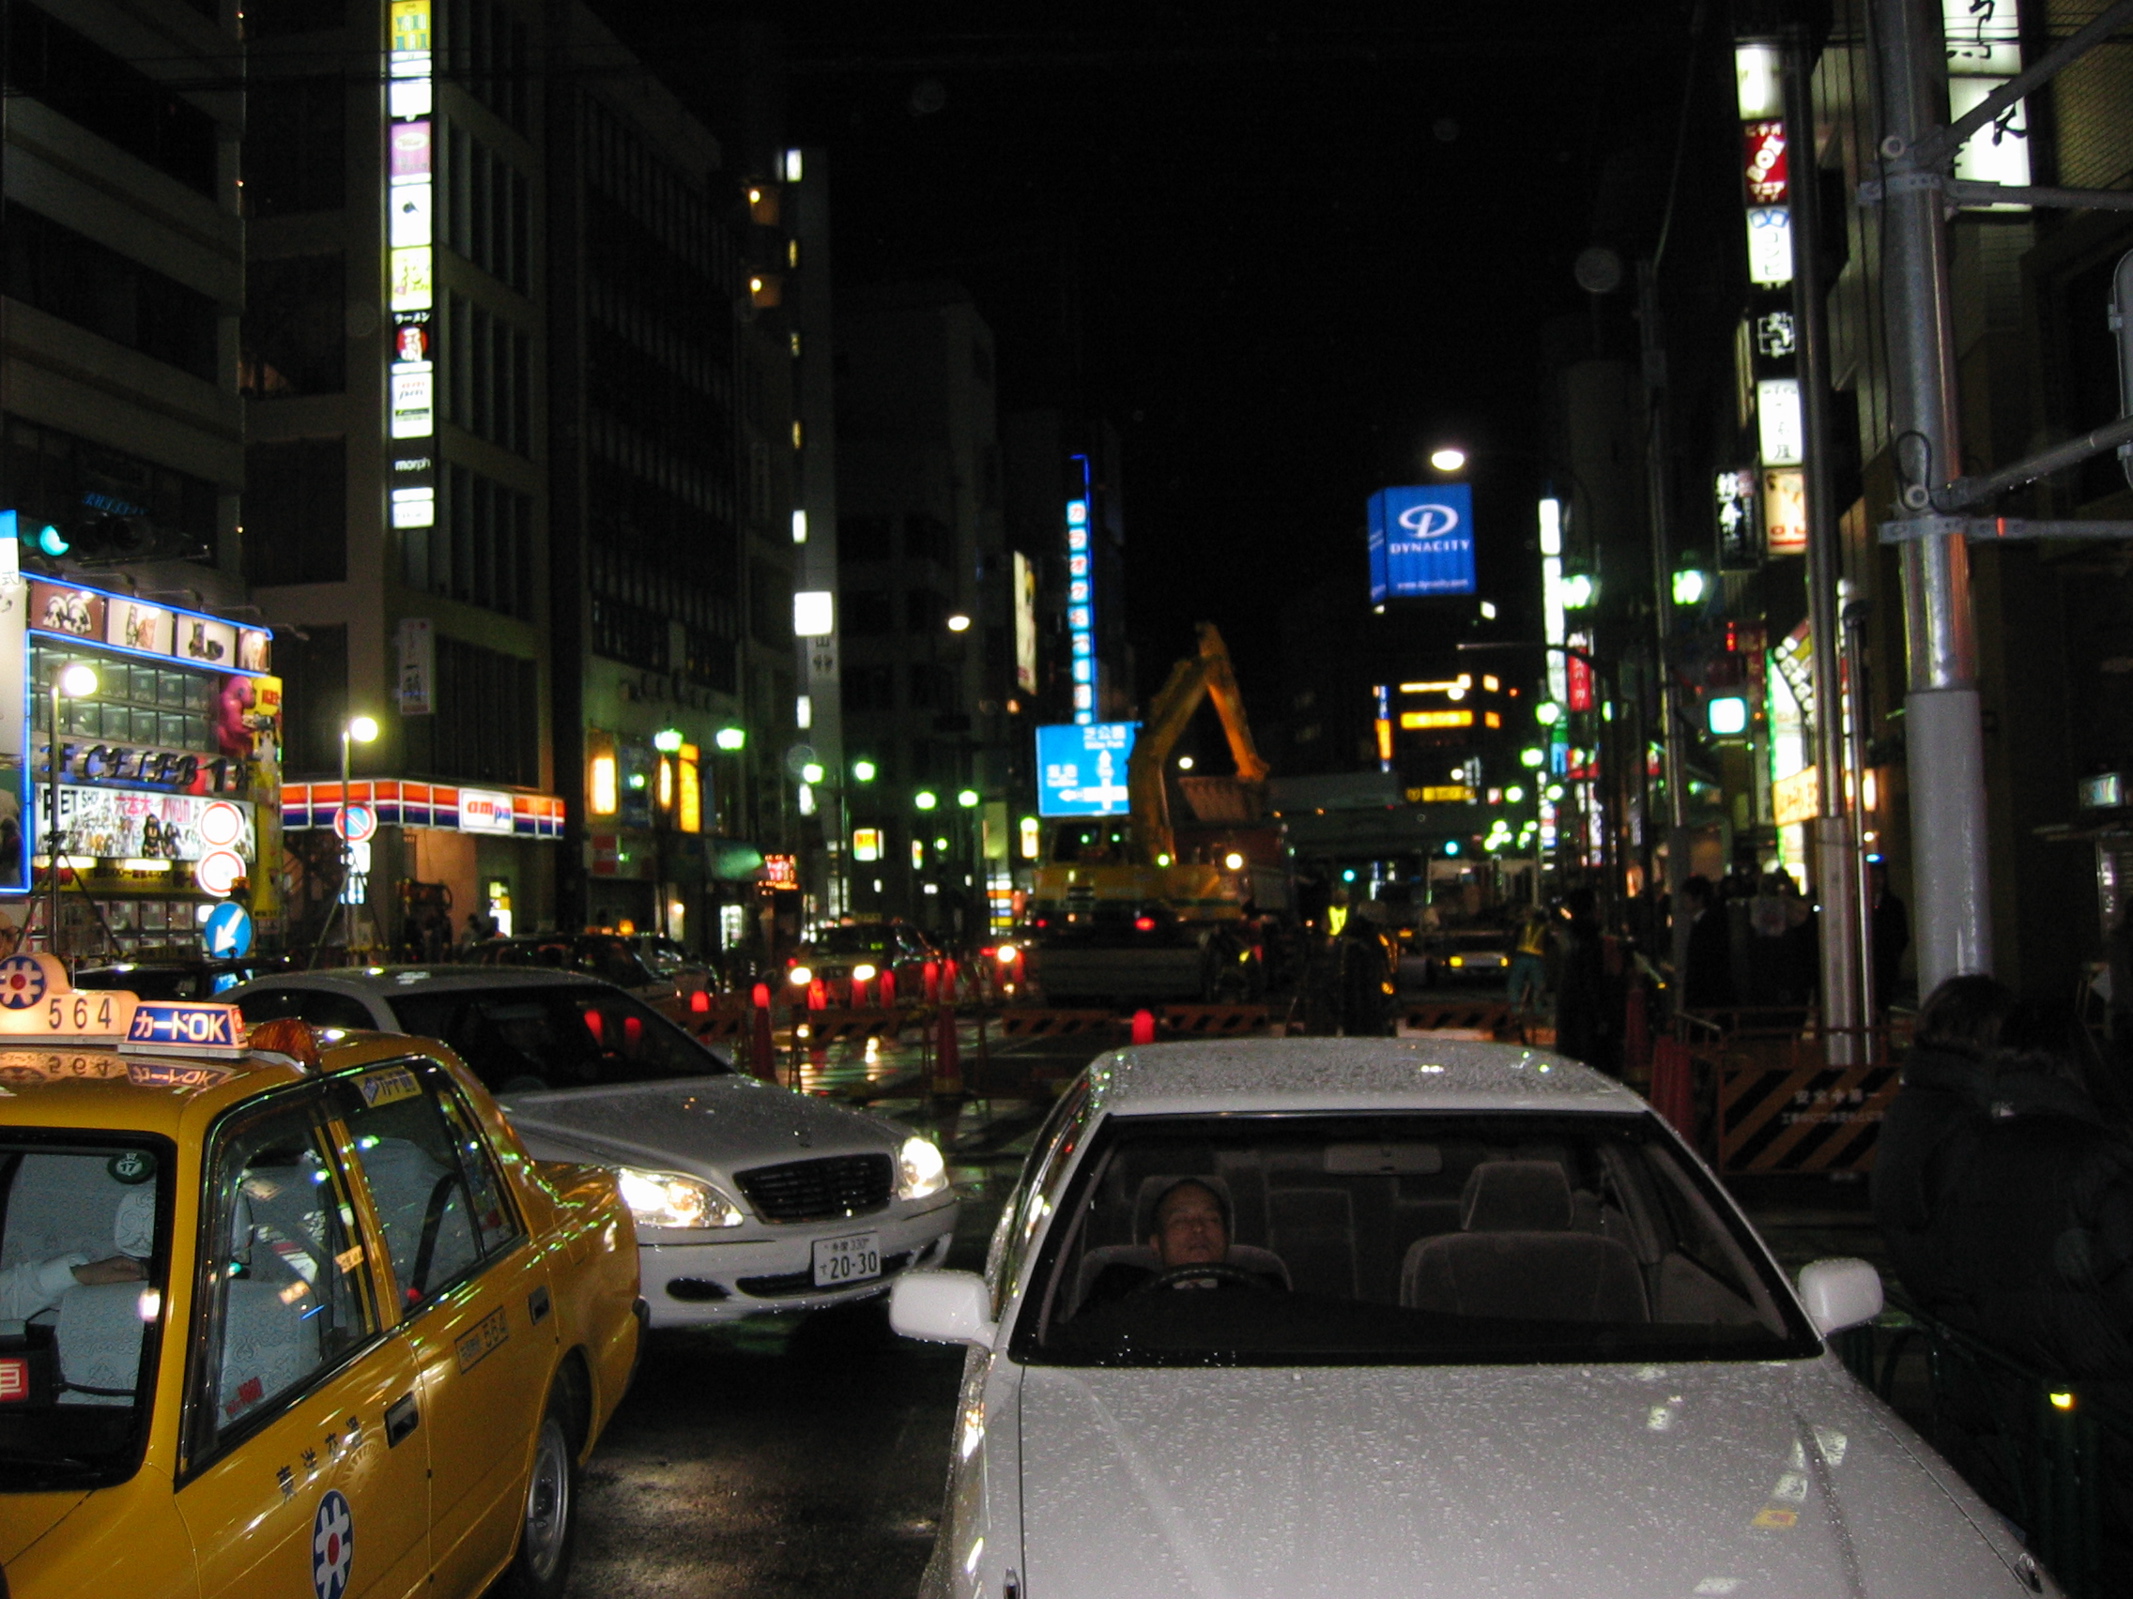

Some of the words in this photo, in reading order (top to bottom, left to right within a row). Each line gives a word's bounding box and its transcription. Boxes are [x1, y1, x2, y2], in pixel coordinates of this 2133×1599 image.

[1746, 135, 1785, 183] BOX
[394, 311, 431, 325] ラーメン
[395, 457, 431, 472] morph
[1389, 539, 1470, 554] DYNACITY
[43, 789, 79, 820] PET
[48, 997, 112, 1030] 564
[134, 1010, 228, 1042] カードOK
[121, 1162, 137, 1173] 17
[830, 1251, 877, 1279] 20-30
